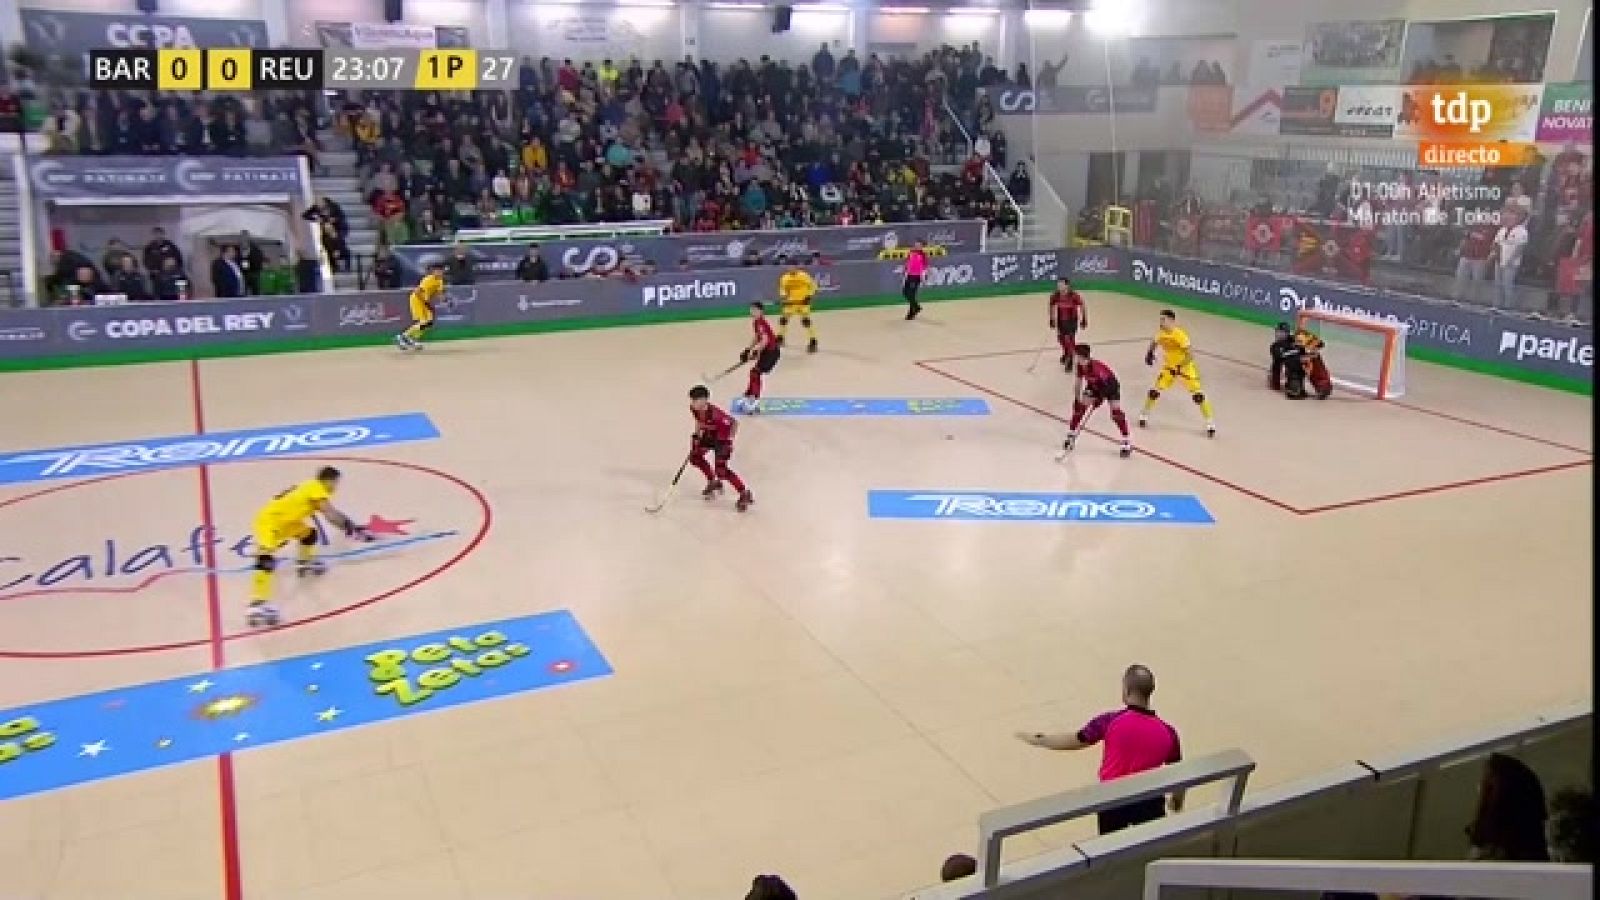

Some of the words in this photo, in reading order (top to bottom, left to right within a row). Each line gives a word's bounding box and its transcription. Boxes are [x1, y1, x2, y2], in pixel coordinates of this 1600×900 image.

[658, 279, 737, 307] parlem
[1156, 265, 1221, 296] MURALLA
[106, 317, 173, 339] COPA
[175, 315, 221, 334] DEL
[224, 311, 275, 331] REY
[364, 630, 508, 683] Beta
[374, 643, 532, 706] Zetas
